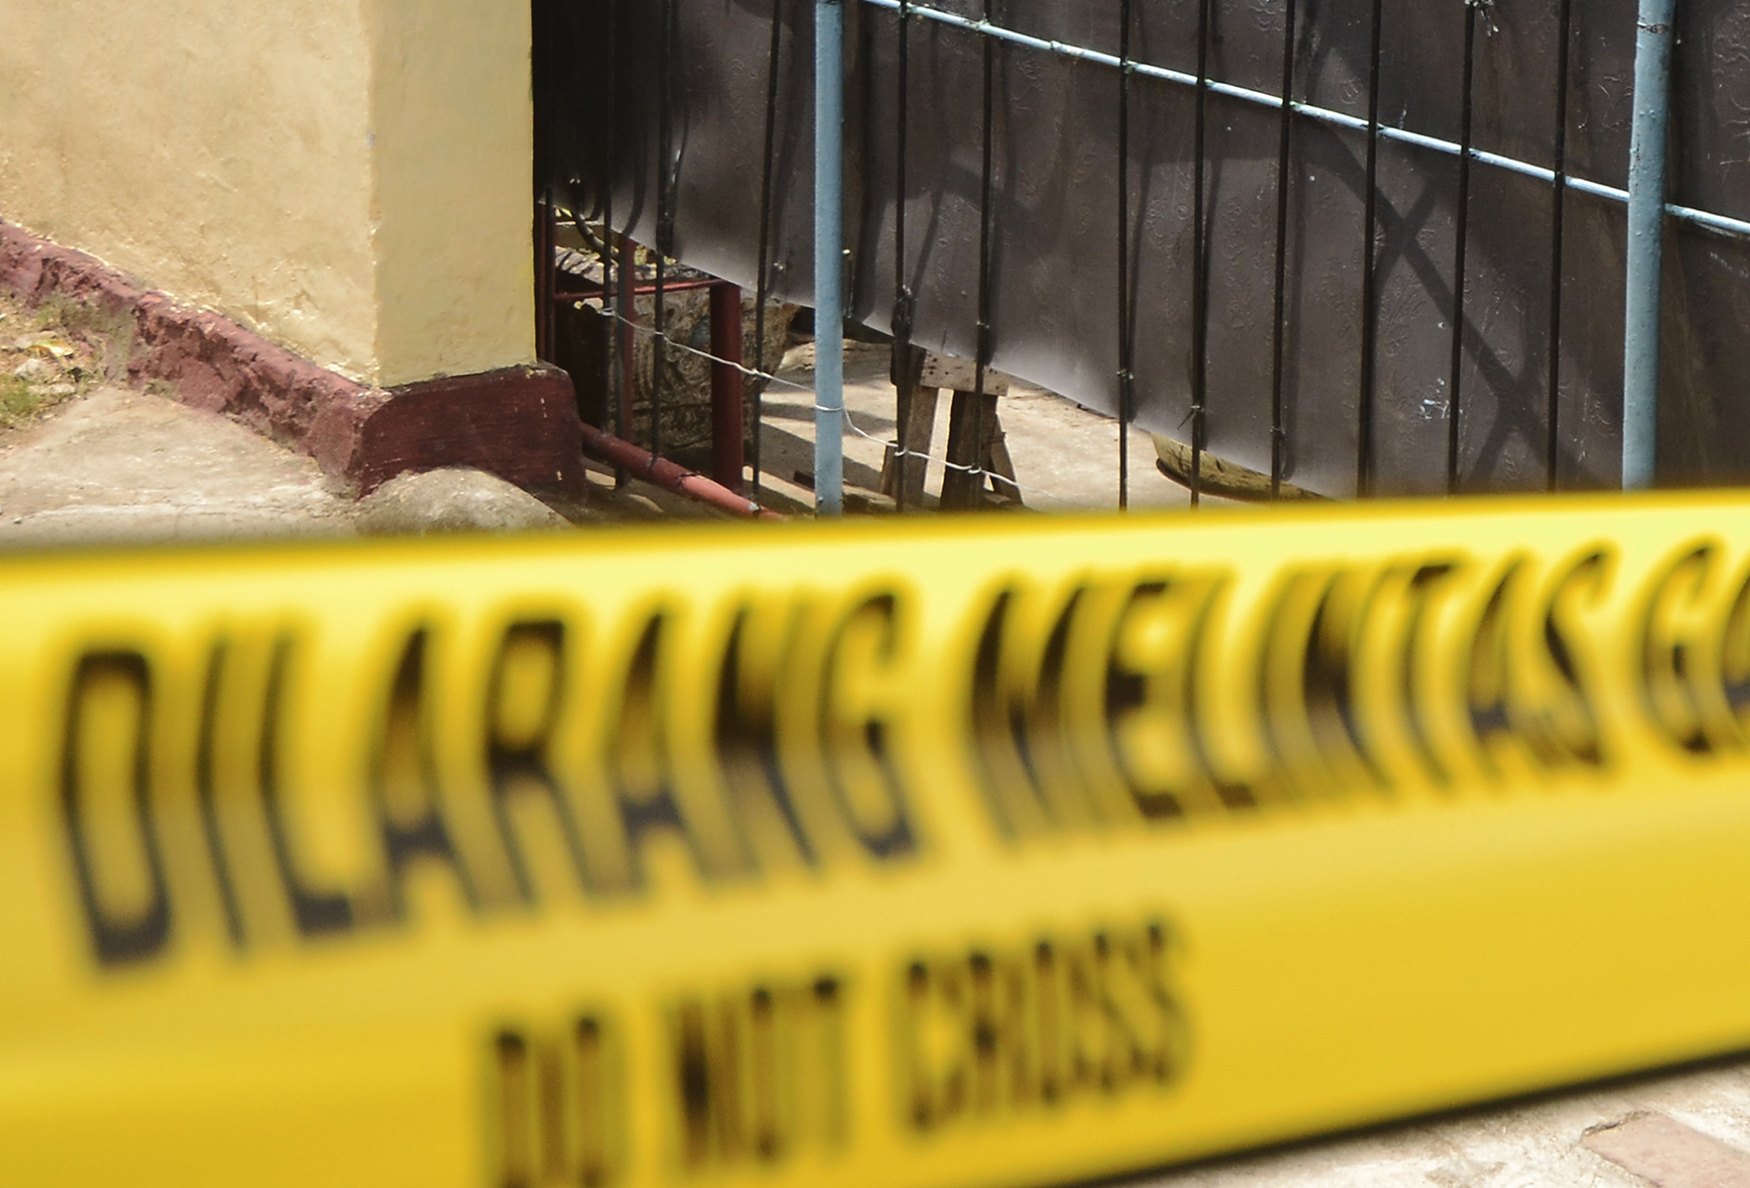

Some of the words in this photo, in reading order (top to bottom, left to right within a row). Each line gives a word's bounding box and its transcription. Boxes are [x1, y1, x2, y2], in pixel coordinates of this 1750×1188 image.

[56, 582, 928, 977] DILARANG
[962, 537, 1620, 842] MELINTAS
[474, 1014, 628, 1188] DO
[668, 972, 850, 1174] NOT
[892, 917, 1192, 1137] CROSS
